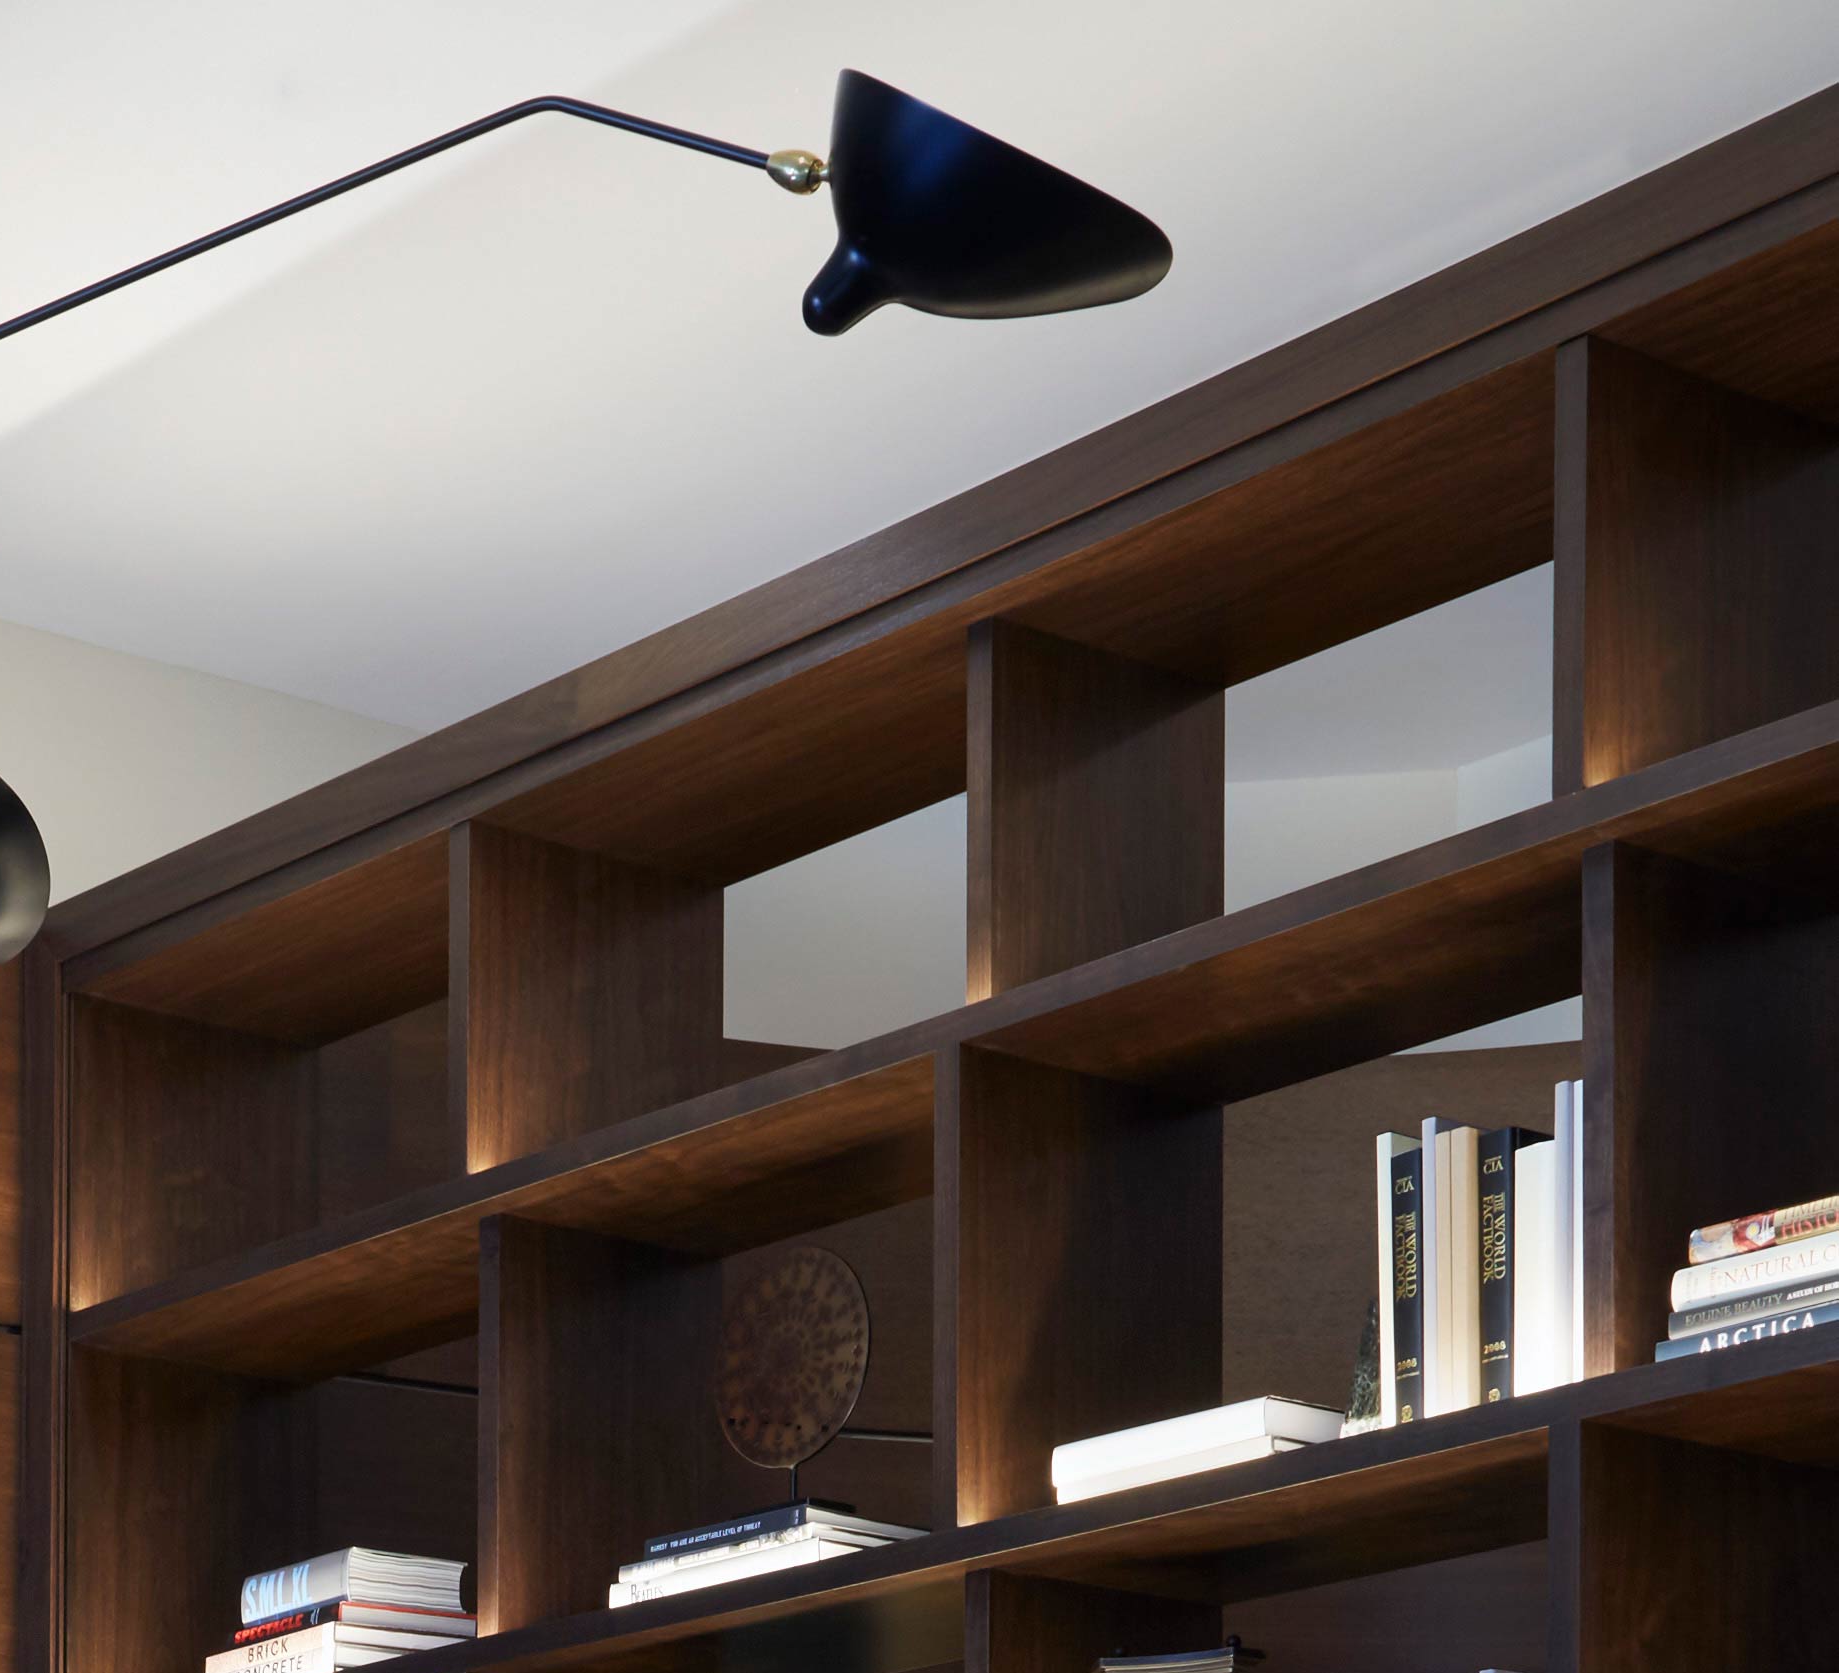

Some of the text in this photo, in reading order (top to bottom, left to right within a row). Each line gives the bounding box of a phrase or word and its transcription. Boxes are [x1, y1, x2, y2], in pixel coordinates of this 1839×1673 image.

[1483, 1160, 1504, 1175] CIA
[1483, 1194, 1494, 1285] FACTBOOK
[1494, 1192, 1506, 1280] THE WORLD
[1395, 1213, 1405, 1303] FACTBOOK
[1405, 1232, 1417, 1298] WORLD
[1724, 1249, 1817, 1284] NATURAL
[1685, 1304, 1731, 1327] EQUINE
[1733, 1292, 1783, 1314] BEAUTY
[1700, 1312, 1815, 1354] ARCTICA
[234, 1613, 304, 1644] SPECTACLE
[247, 1638, 288, 1663] BRICK
